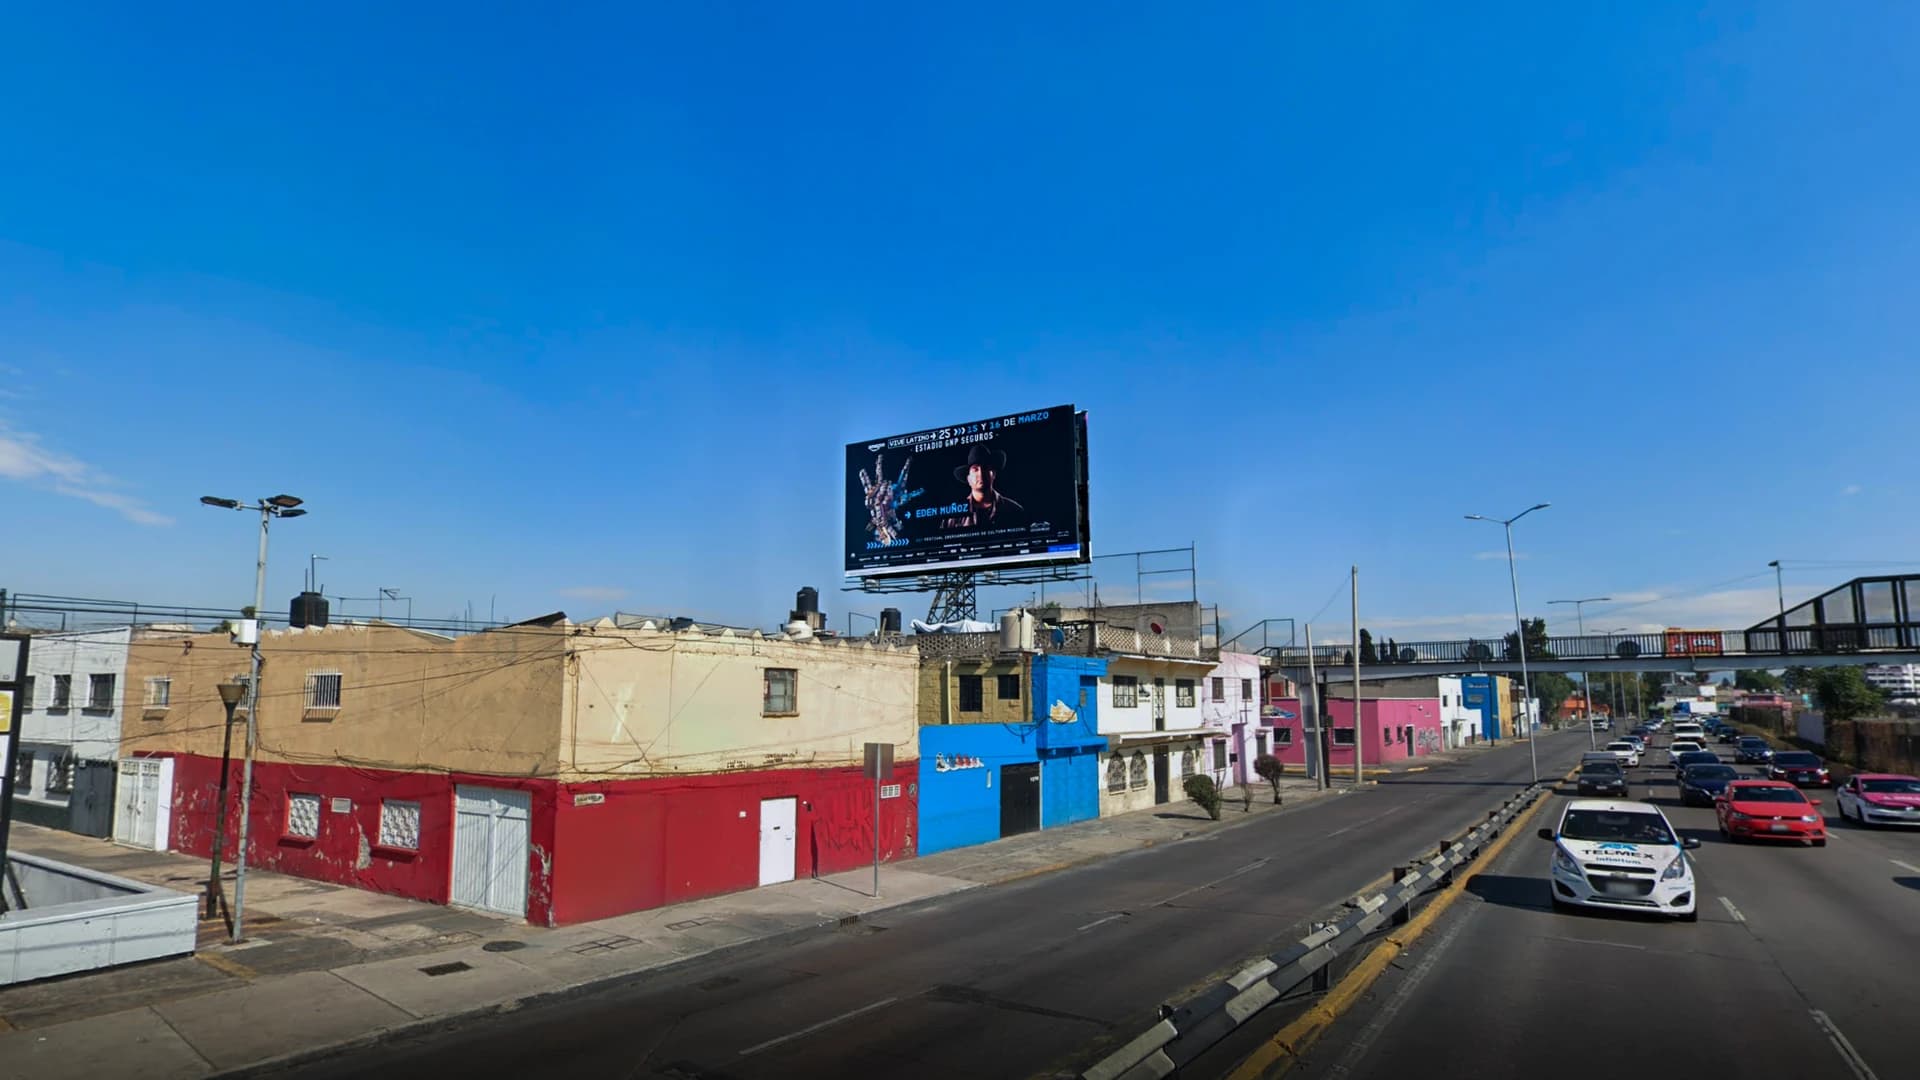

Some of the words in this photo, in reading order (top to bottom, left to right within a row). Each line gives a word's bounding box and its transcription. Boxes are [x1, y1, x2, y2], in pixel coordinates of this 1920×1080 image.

[889, 439, 904, 447] VIVE
[906, 434, 929, 444] LATINO
[938, 428, 951, 440] 25
[967, 424, 978, 433] 15
[980, 422, 987, 431] Y
[989, 420, 1001, 430] 16
[1003, 417, 1016, 427] DE
[1018, 411, 1049, 424] MARZO
[915, 440, 943, 453] ESTADIO
[945, 437, 959, 448] GNP
[960, 431, 994, 445] SEGUROS
[915, 507, 938, 518] EDEN
[940, 502, 969, 515] MUÑOZ
[1582, 849, 1655, 860] TELMEX
